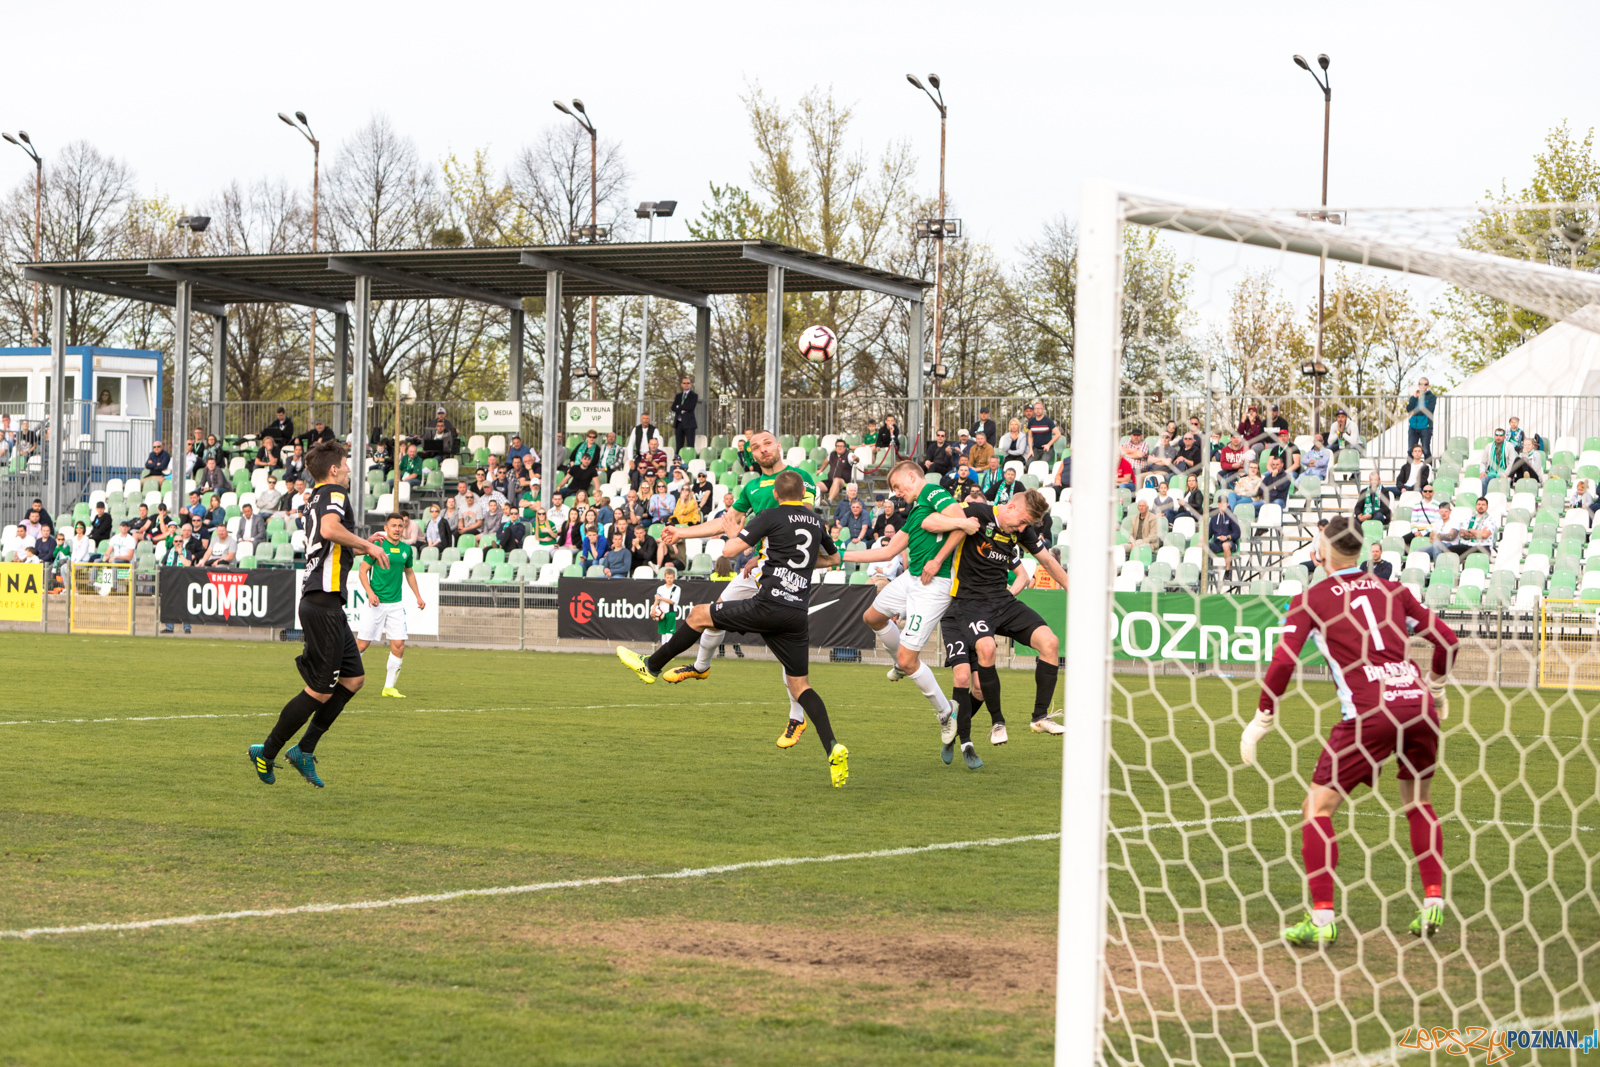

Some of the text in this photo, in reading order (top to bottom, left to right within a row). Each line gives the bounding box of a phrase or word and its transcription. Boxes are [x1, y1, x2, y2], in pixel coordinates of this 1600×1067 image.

[493, 409, 513, 417] MEDIA
[788, 514, 821, 528] KAWULA
[787, 528, 813, 569] 3
[0, 573, 38, 594] NA
[103, 572, 112, 584] 32
[211, 574, 243, 582] ENERGY
[1330, 579, 1381, 597] DRAZIK
[186, 582, 269, 618] COMBU
[908, 614, 922, 632] 13
[968, 619, 989, 636] 16
[1350, 595, 1386, 651] 1
[946, 640, 966, 659] 22
